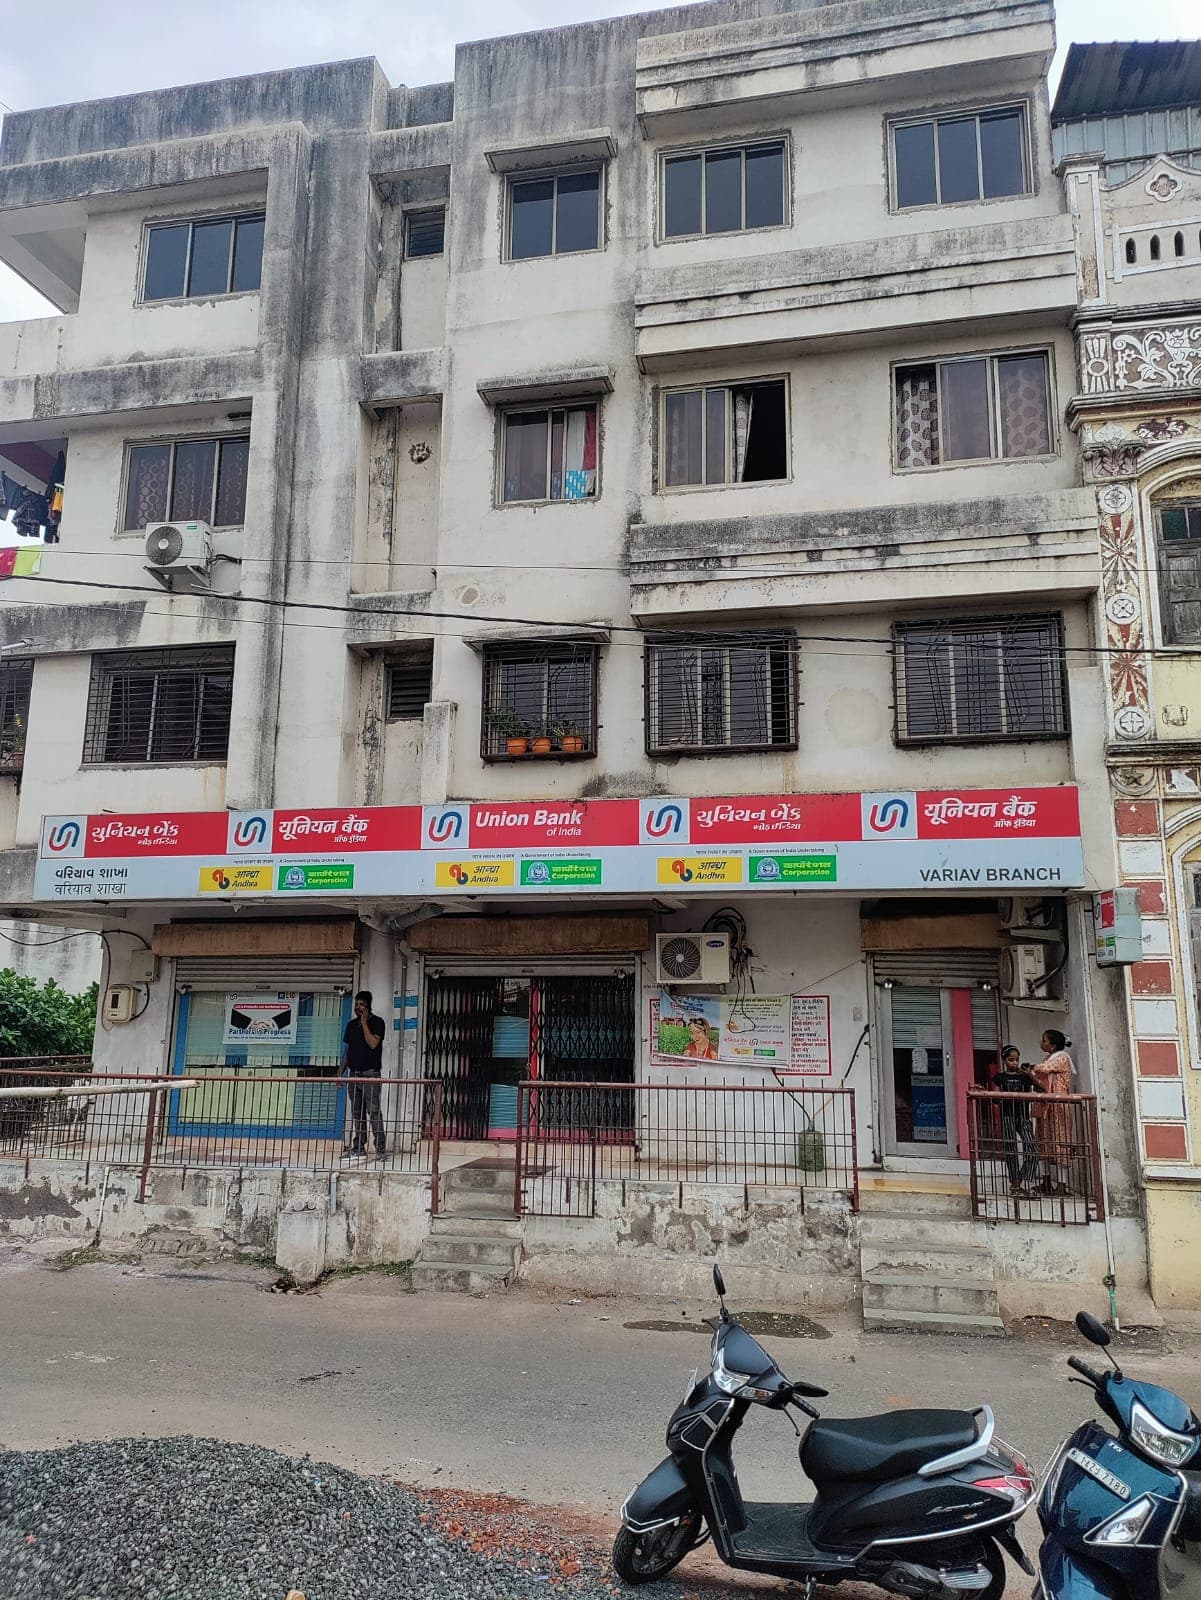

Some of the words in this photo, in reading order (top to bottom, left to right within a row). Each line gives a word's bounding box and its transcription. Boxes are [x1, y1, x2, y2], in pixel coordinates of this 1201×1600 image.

[924, 798, 998, 825] यूनियन
[1002, 795, 1038, 817] बैंक
[476, 811, 529, 827] Union
[533, 810, 584, 826] Bank
[696, 805, 765, 828] યુનિયન
[278, 815, 338, 840] यूनियन
[341, 814, 369, 833] बैंक
[993, 819, 1011, 829] ऑफ
[91, 822, 150, 843] યુનિયન
[546, 827, 557, 836] of
[558, 826, 582, 836] India
[55, 866, 94, 879] વરિયાવ
[99, 868, 128, 878] શાખા
[551, 872, 595, 880] Corporation
[695, 872, 725, 880] Andhra
[782, 869, 830, 877] Corporation
[920, 868, 981, 882] VARIAV
[986, 868, 1061, 881] BRANCH
[231, 880, 258, 888] Andhra
[307, 877, 348, 885] Corporation
[470, 875, 499, 883] Andhra
[54, 881, 92, 896] वरियाव
[97, 883, 128, 895] शाखा
